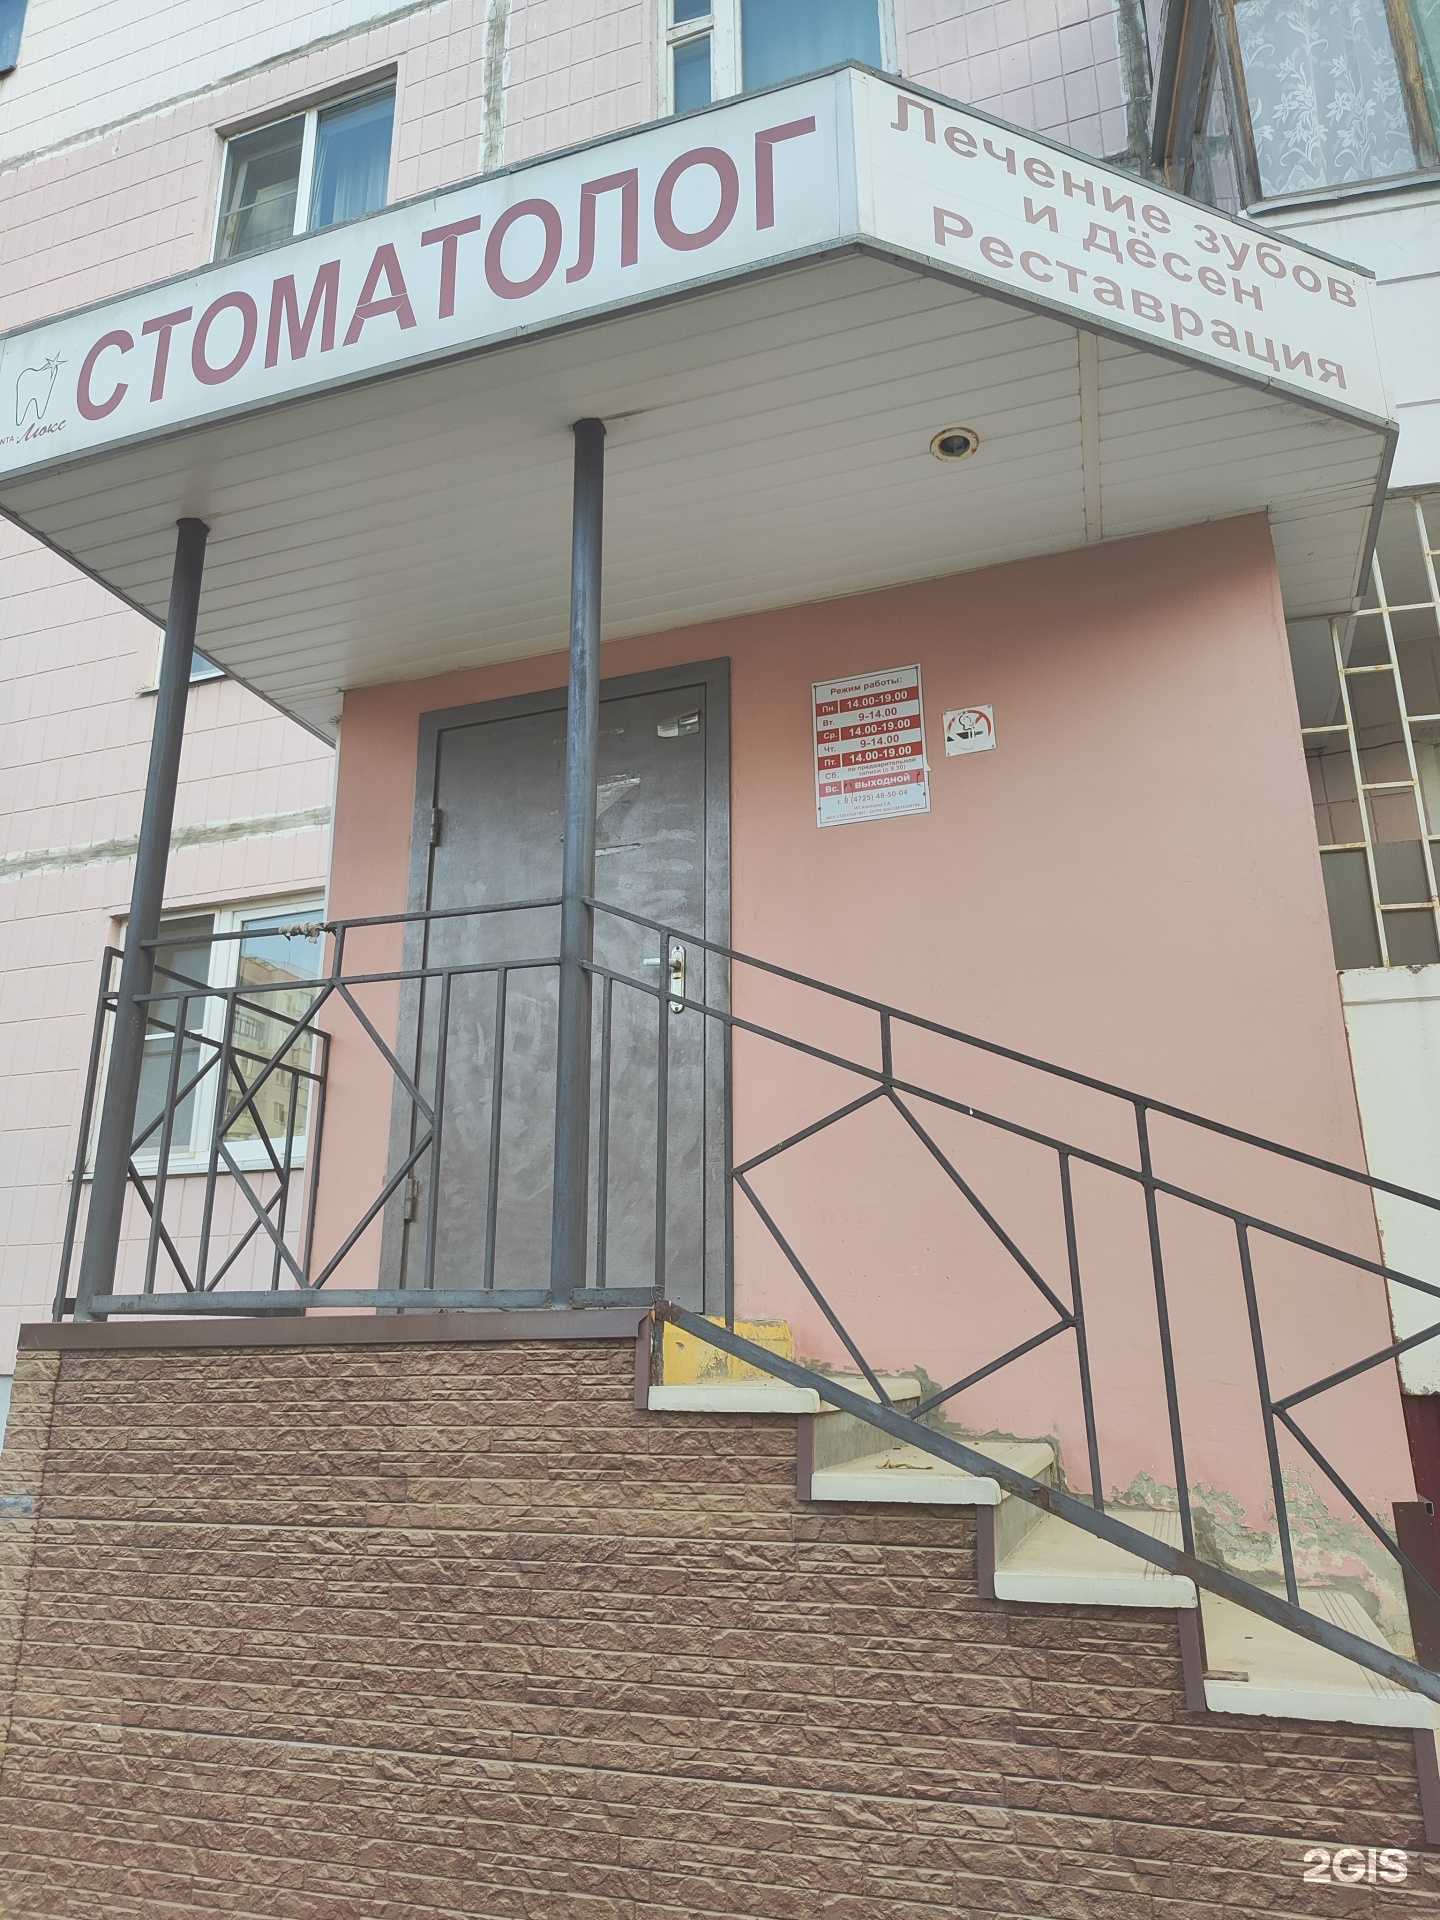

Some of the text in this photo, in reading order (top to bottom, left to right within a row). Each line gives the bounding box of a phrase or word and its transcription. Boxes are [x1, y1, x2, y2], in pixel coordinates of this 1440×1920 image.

[890, 94, 1358, 309] Лечение зубов
[1023, 196, 1264, 312] и дёсен
[76, 115, 817, 422] СТОМАТОЛОГ
[932, 206, 1349, 391] Реставрация
[830, 677, 903, 695] Режим работы:
[847, 691, 908, 708] 14.00-19.00
[858, 707, 898, 721] 9-14.00
[823, 719, 911, 742] Ср. 14.00-19.00
[860, 734, 900, 748] 9-14.00
[850, 746, 912, 763] 14.00-19.00
